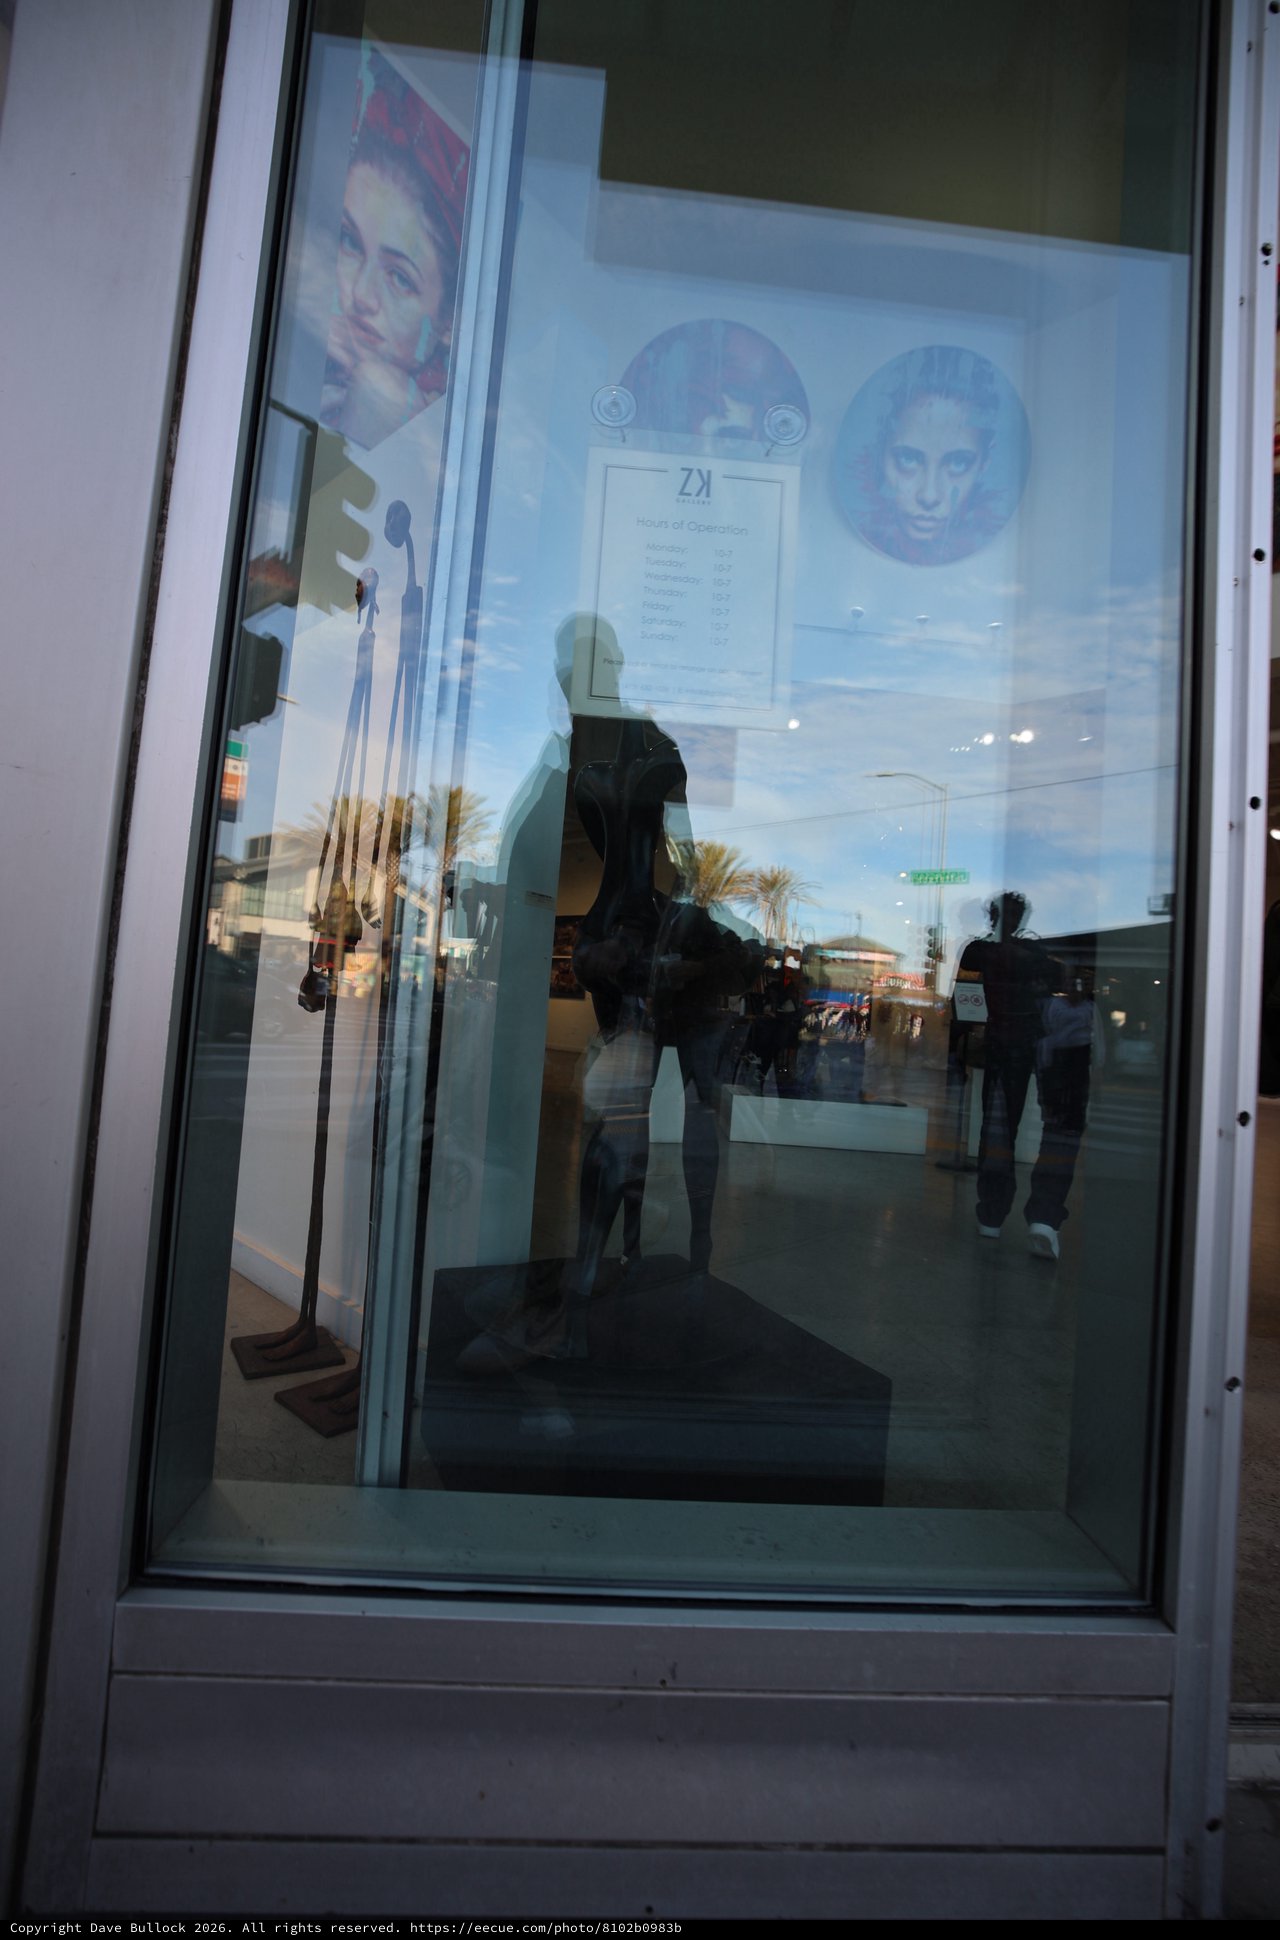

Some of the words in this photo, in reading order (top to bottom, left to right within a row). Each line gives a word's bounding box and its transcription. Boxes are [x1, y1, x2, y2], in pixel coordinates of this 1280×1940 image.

[636, 517, 669, 529] Hours
[672, 520, 684, 530] of
[687, 521, 748, 536] Operation
[646, 543, 688, 555] Monday:
[714, 549, 733, 558] 10-7
[645, 557, 687, 568] Tuesday:
[713, 563, 732, 572] 10-7
[644, 572, 703, 585] Wednesday:
[713, 578, 732, 587] 10-7
[643, 586, 687, 599] Thursday:
[712, 592, 731, 602] 10-7
[642, 600, 673, 613] Friday:
[711, 608, 730, 616] 10-7
[640, 616, 687, 629] Saturday:
[710, 622, 729, 631] 10-7
[640, 631, 679, 642] Sunday:
[710, 637, 729, 647] 10-7
